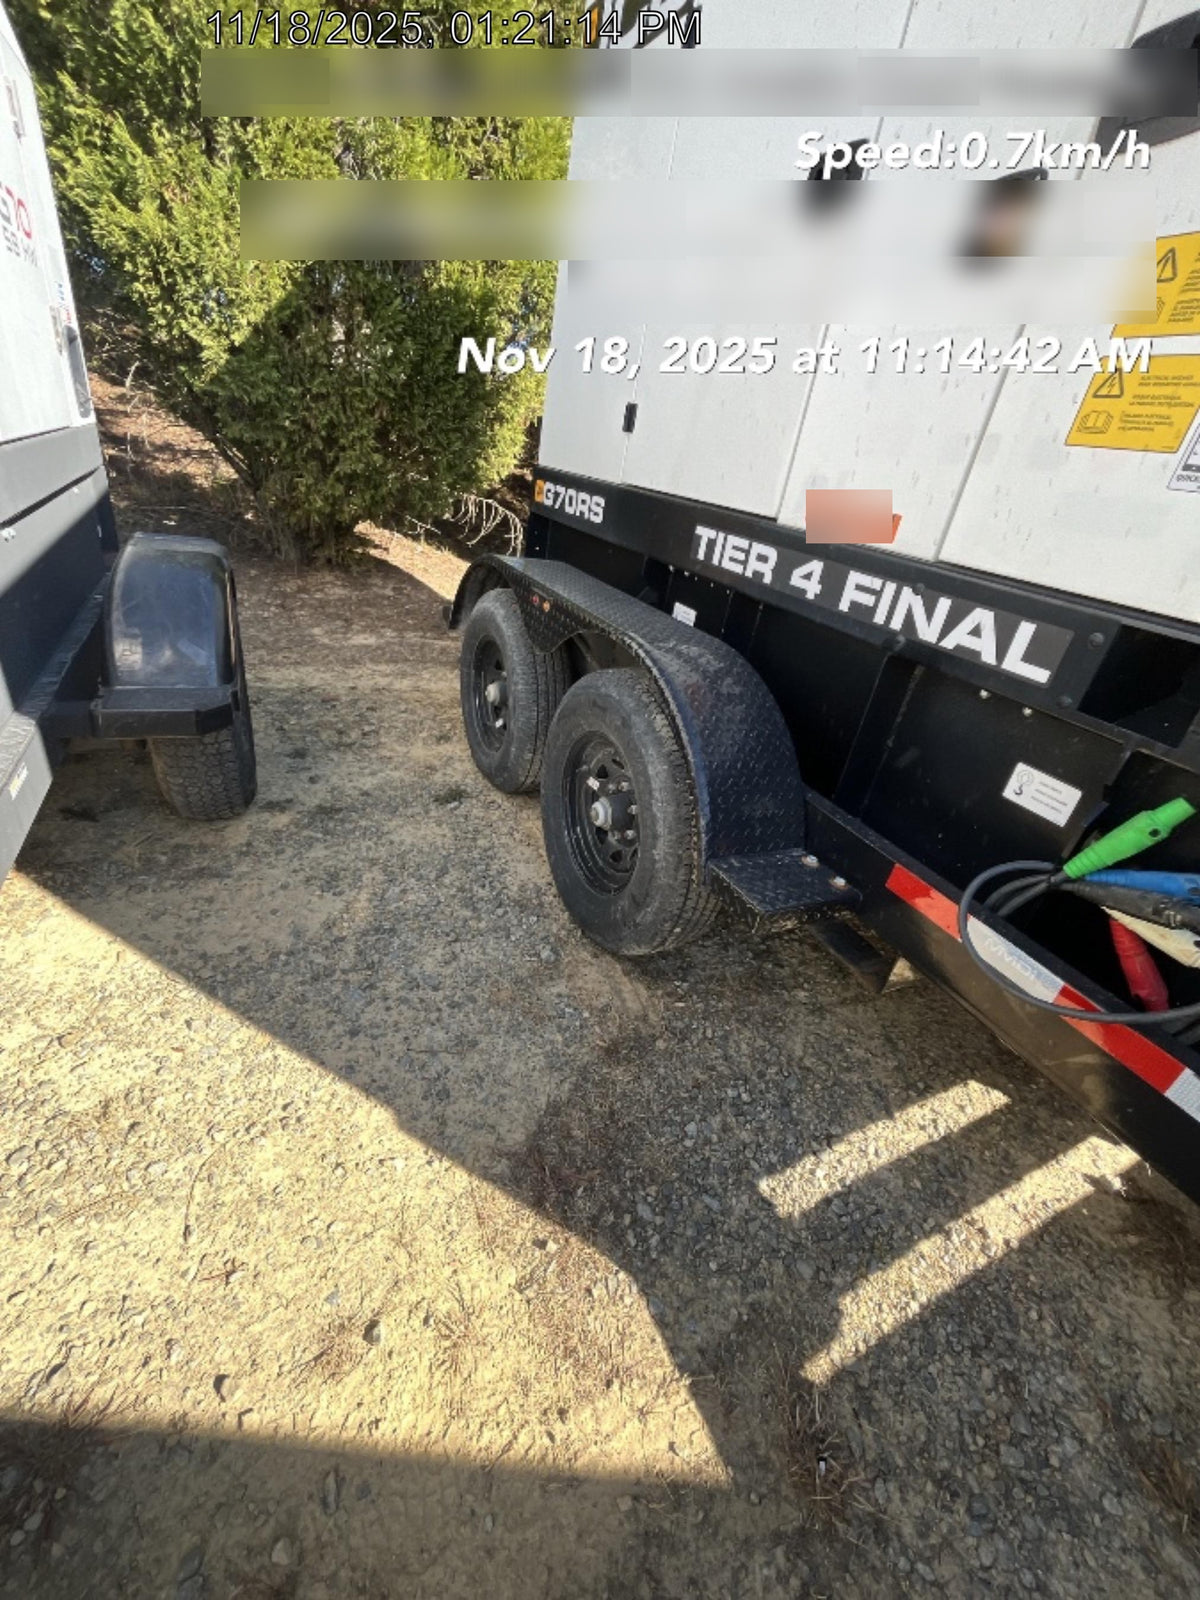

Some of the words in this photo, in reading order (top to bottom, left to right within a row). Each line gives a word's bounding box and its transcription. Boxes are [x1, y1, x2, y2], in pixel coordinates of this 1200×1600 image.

[693, 525, 778, 584] TIER
[789, 554, 824, 600] 4
[838, 570, 1052, 684] FINAL
